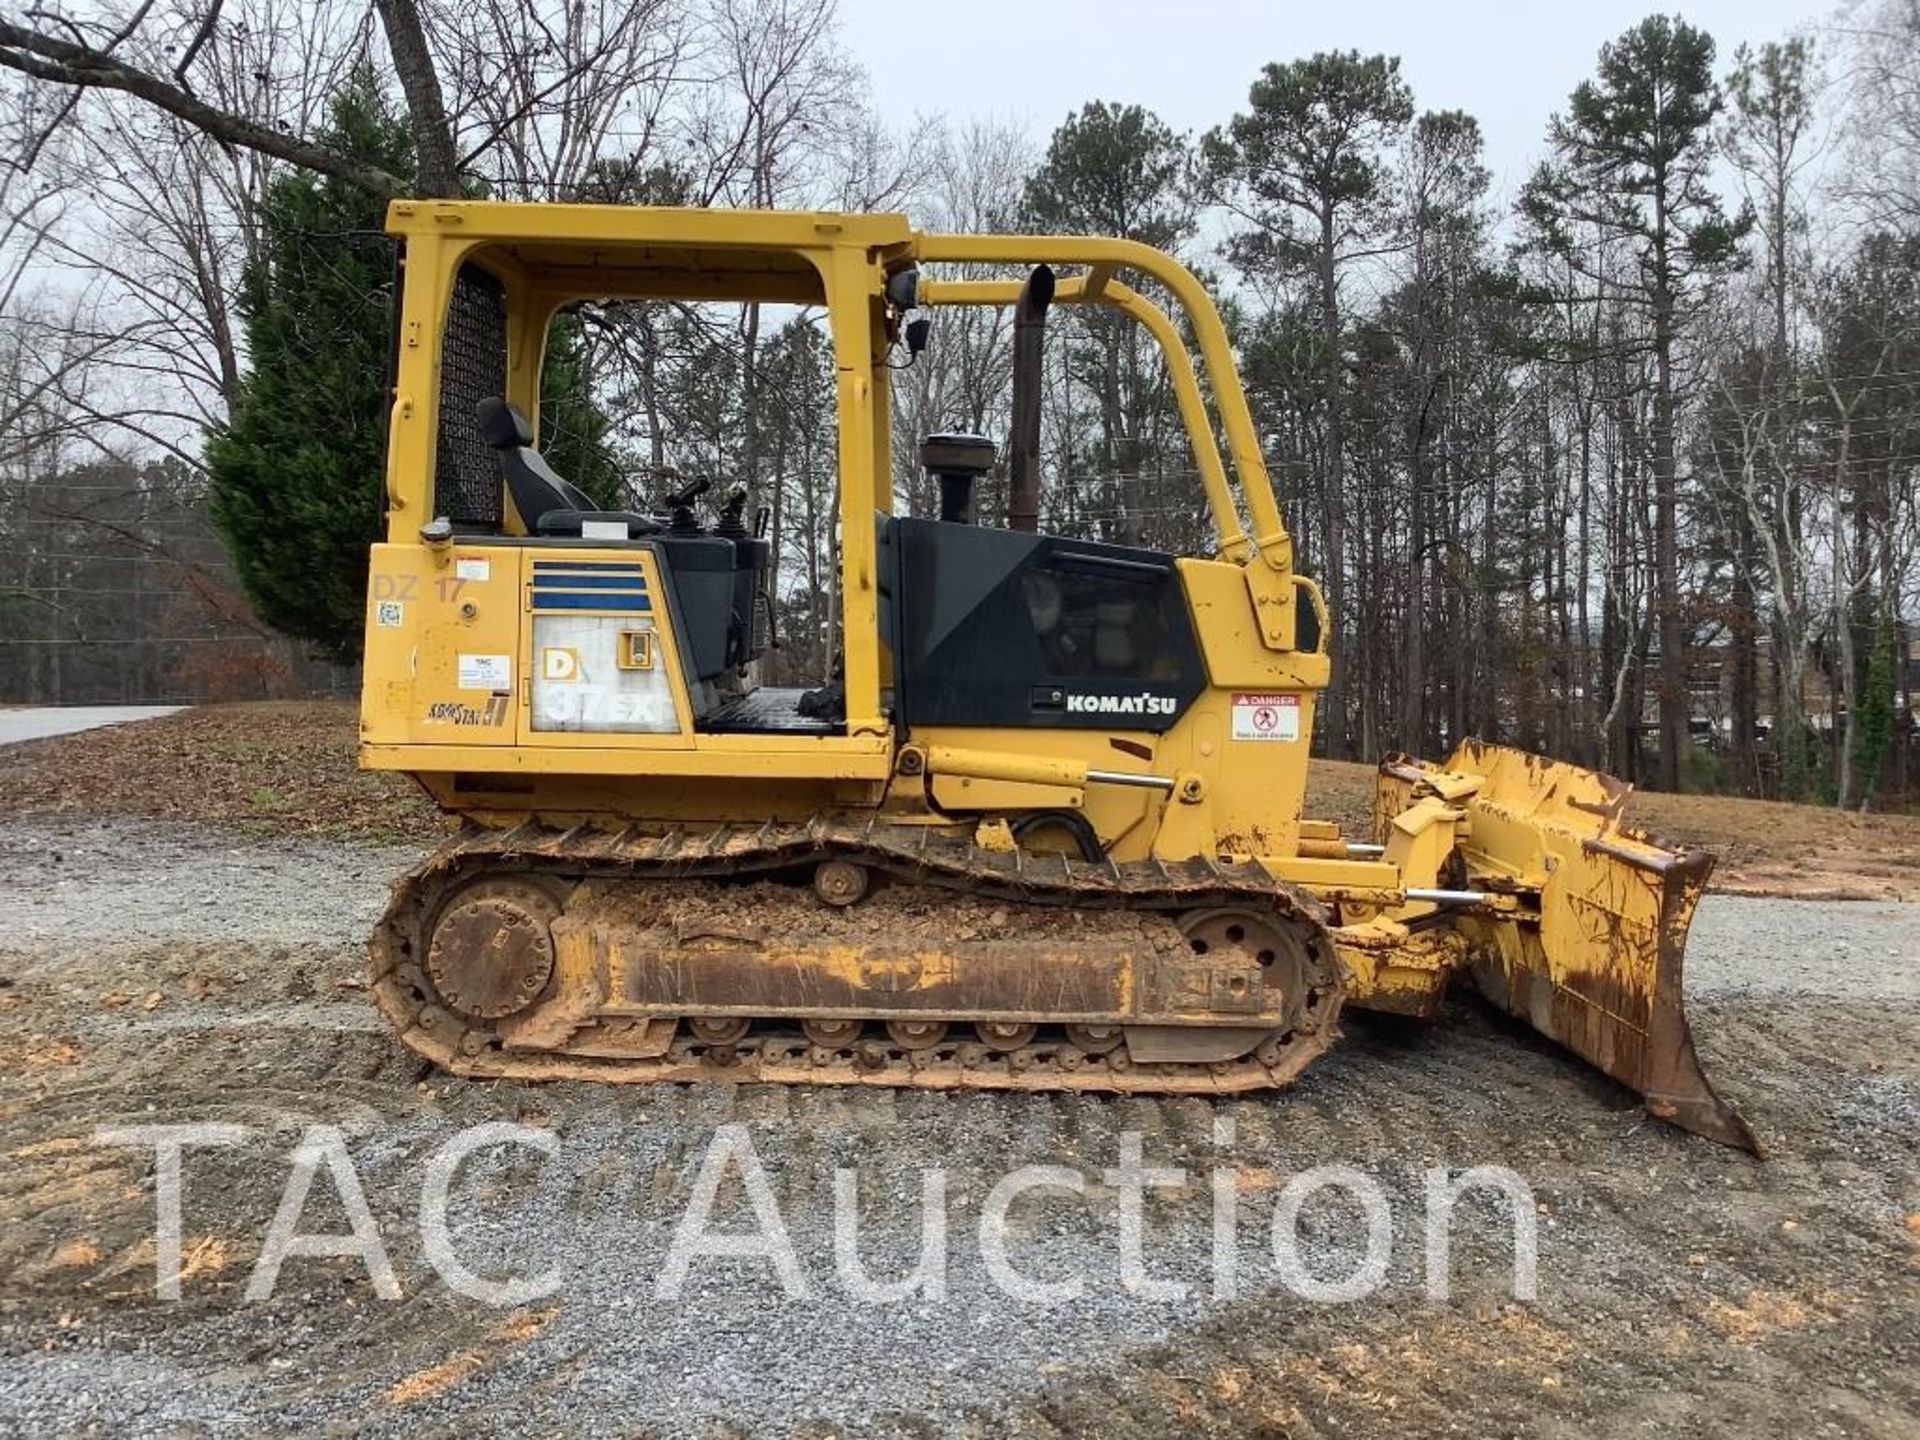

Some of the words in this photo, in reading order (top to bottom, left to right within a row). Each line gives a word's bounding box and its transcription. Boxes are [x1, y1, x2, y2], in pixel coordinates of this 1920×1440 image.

[374, 574, 418, 600] DZ
[434, 577, 467, 602] 17
[545, 649, 575, 679] D
[1067, 692, 1177, 714] KOMATSU
[1250, 695, 1296, 705] DANGER
